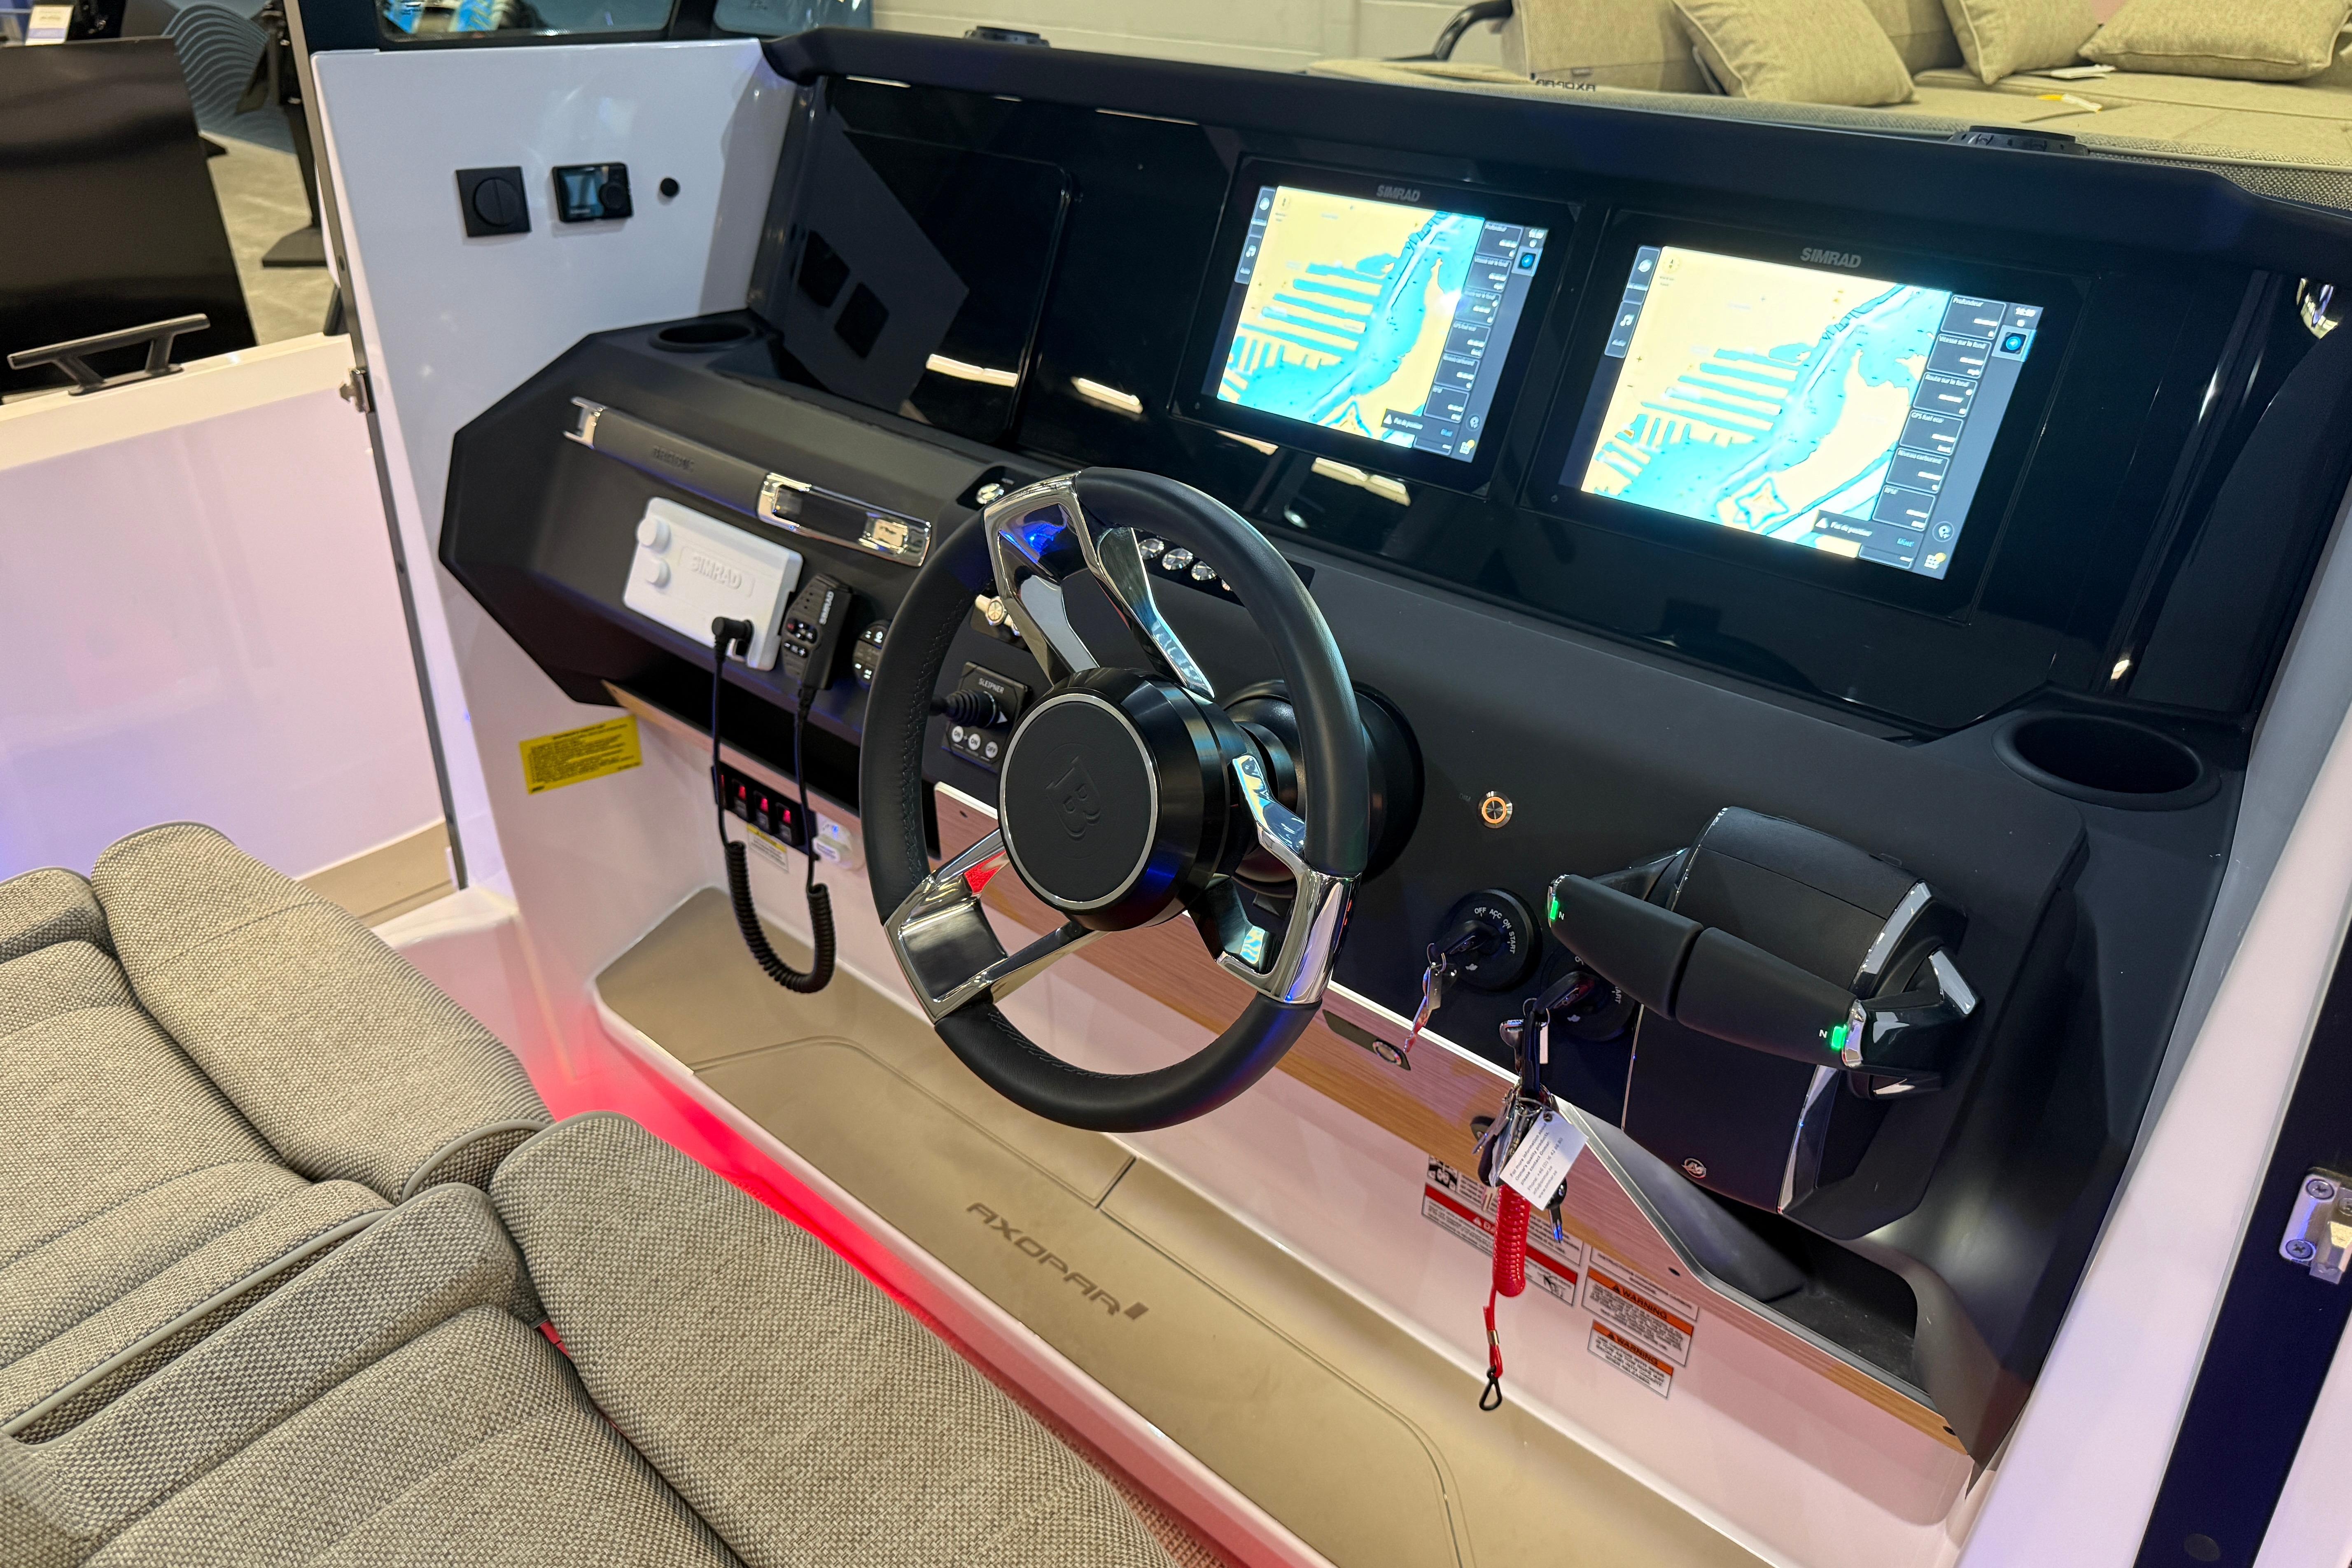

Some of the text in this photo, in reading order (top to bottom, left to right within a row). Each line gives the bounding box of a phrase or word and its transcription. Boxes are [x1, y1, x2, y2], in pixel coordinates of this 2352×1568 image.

[1376, 185, 1420, 202] SIMRAD
[1800, 247, 1861, 268] SIMRAD
[1953, 297, 1983, 307] Profondeur
[1939, 336, 1958, 344] Vitesse
[692, 556, 742, 589] SIMRAD
[819, 590, 834, 625] SIMRAD
[978, 678, 1004, 694] SLEIPNER
[1489, 909, 1502, 919] ACC
[1503, 919, 1512, 929] ON
[1559, 911, 1564, 920] N
[1819, 1029, 1827, 1038] N
[1515, 1158, 1524, 1169] more
[1522, 1134, 1539, 1157] information
[1526, 1150, 1537, 1164] quality
[1520, 1171, 1531, 1185] please
[1529, 1155, 1540, 1171] contact
[966, 1202, 1120, 1316] AXOPAR
[1623, 1291, 1667, 1320] WARNING
[1617, 1337, 1659, 1366] WARNING
